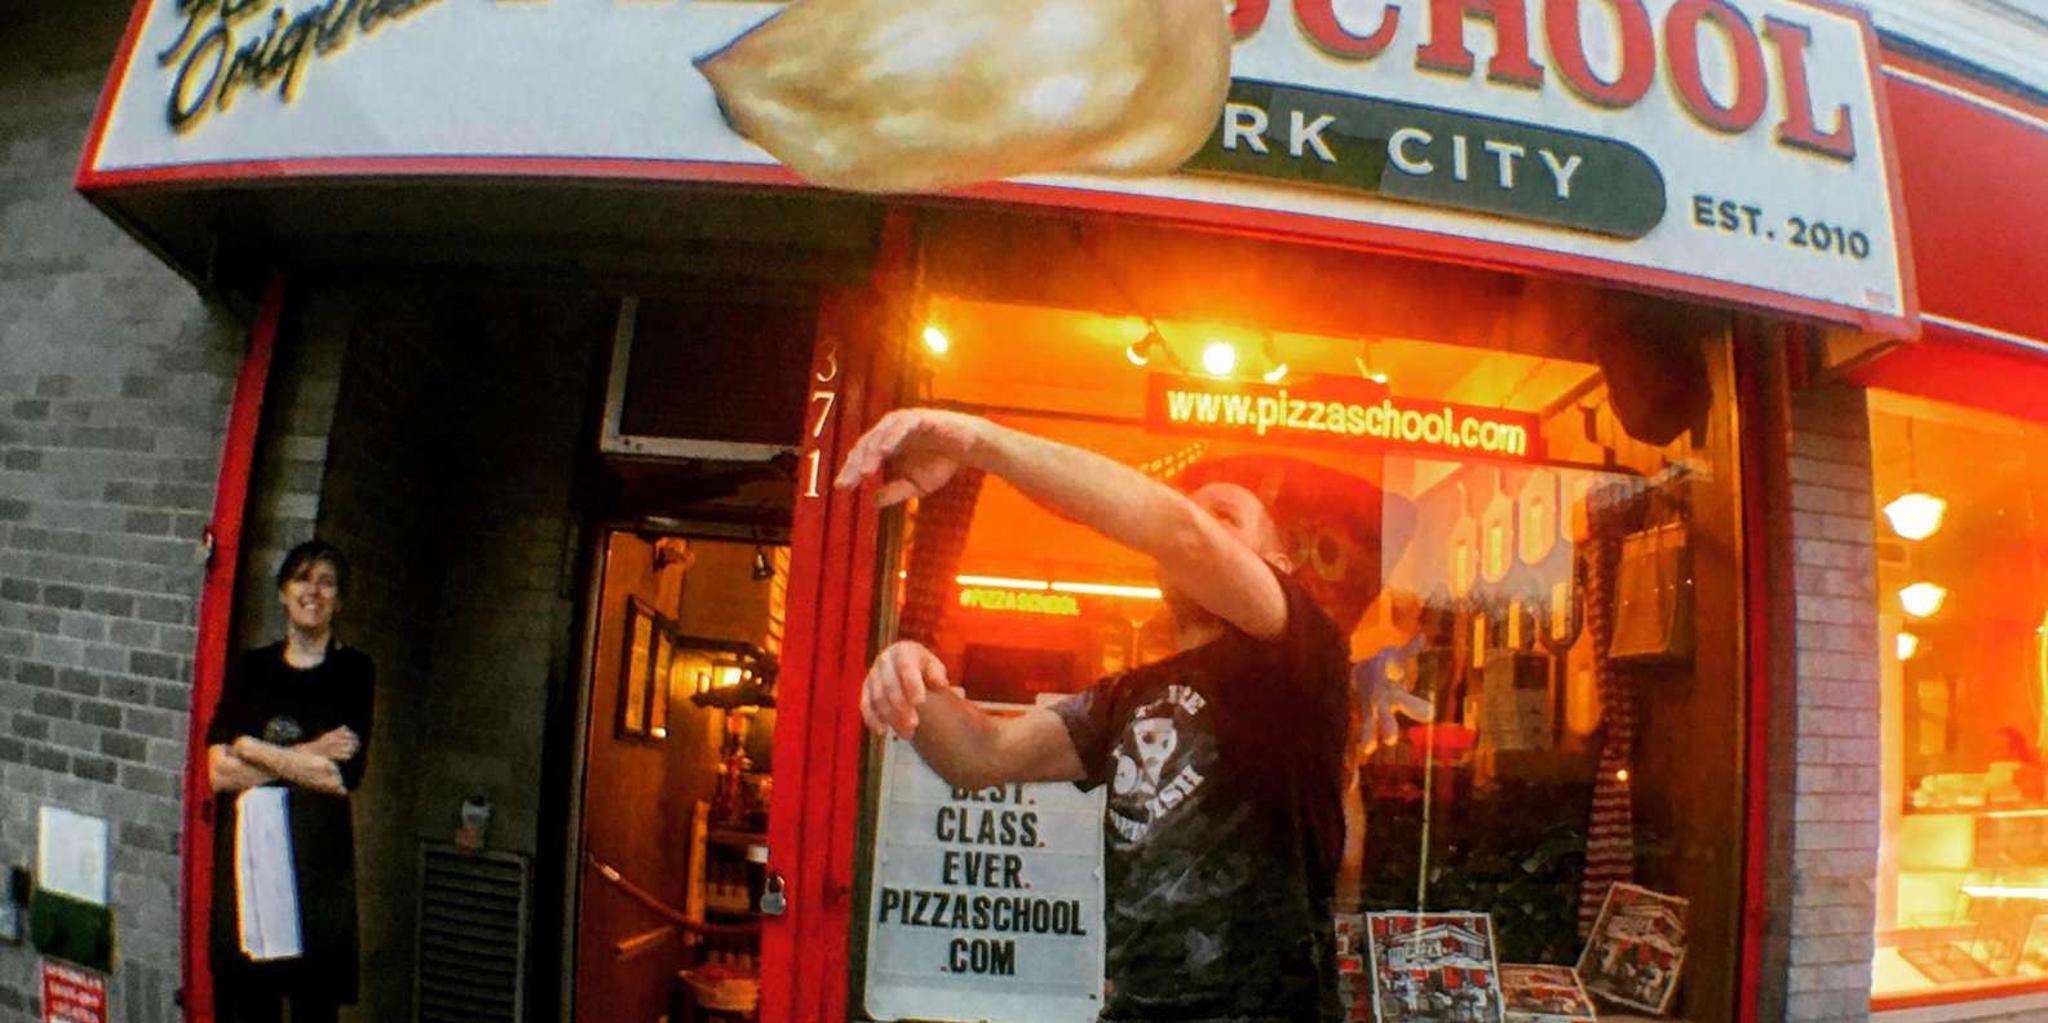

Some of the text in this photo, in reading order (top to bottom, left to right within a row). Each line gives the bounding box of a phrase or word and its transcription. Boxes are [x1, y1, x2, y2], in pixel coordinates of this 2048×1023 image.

[1386, 127, 1583, 200] CITY
[1692, 195, 1871, 260] EST. 2010
[1167, 390, 1526, 456] www.pizzaschool.com
[936, 806, 1046, 848] CLASS.
[942, 850, 1031, 890] EVER.
[878, 887, 1086, 936] PIZZASCHOOL
[940, 937, 1016, 976] .COM
